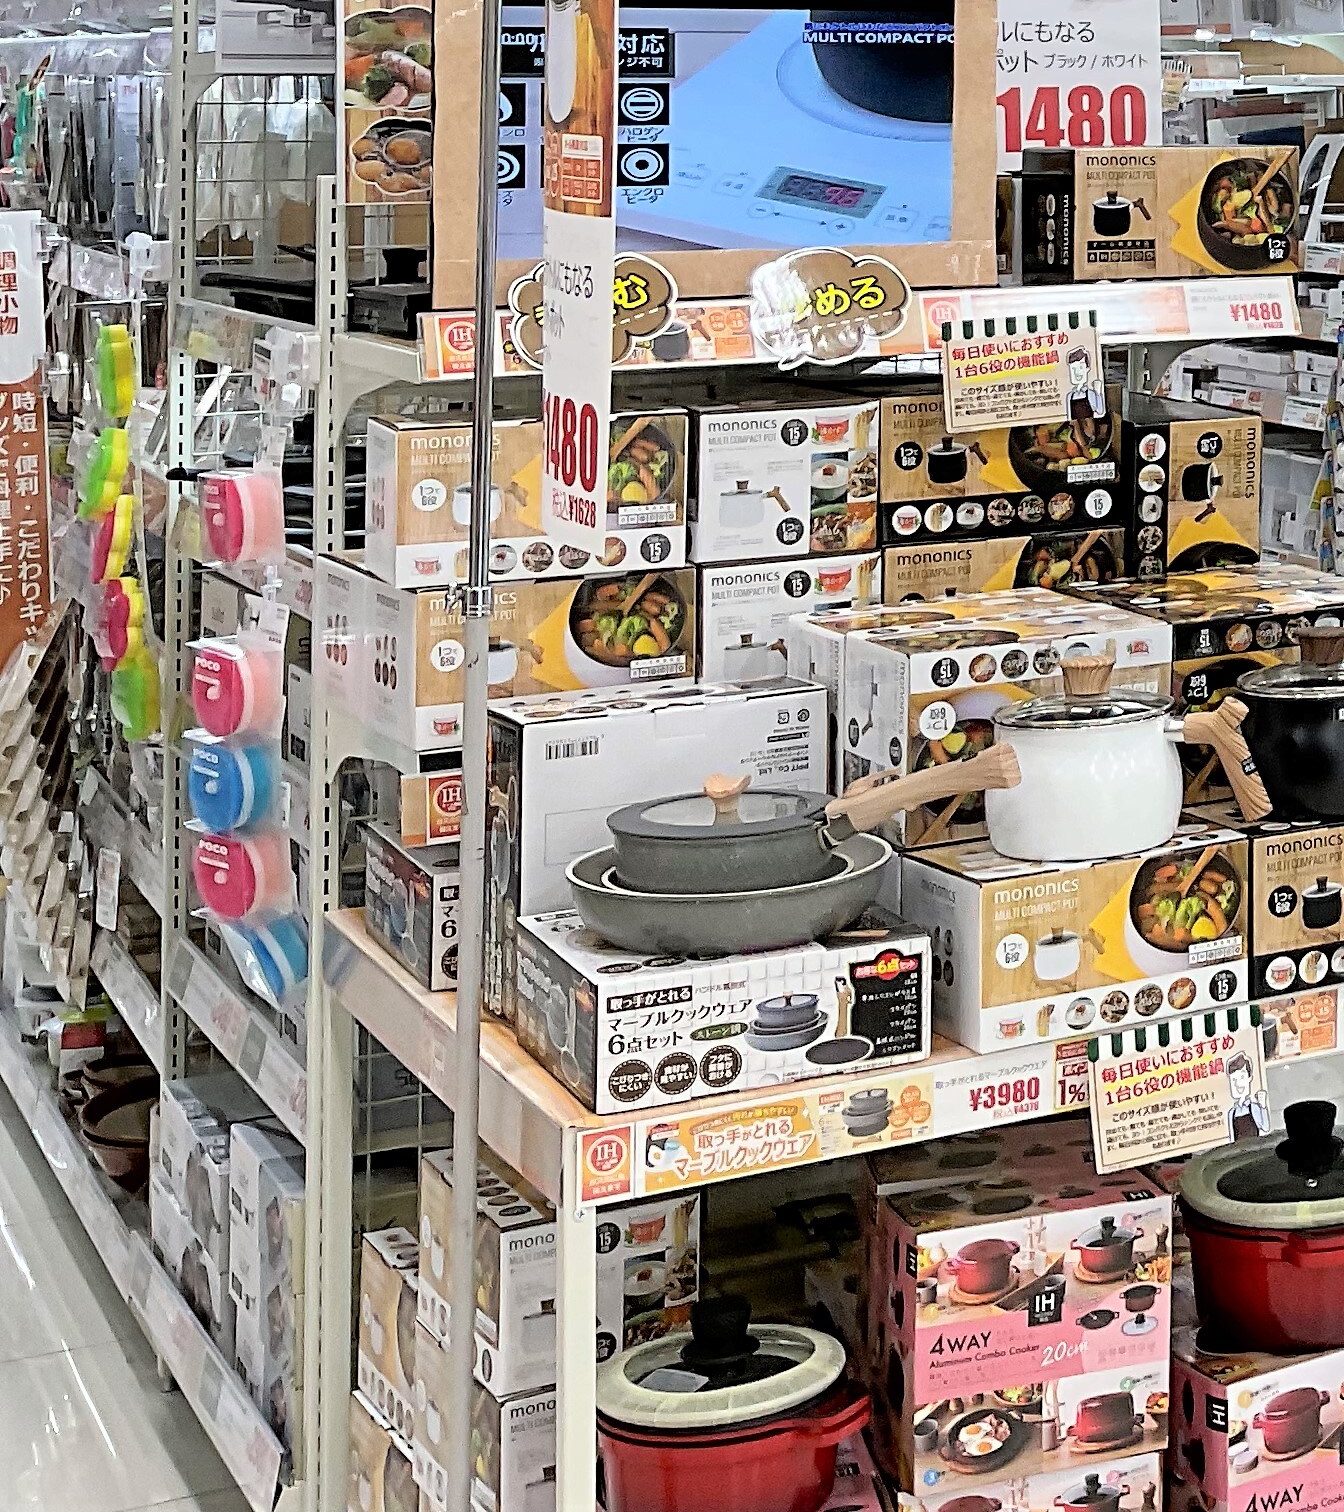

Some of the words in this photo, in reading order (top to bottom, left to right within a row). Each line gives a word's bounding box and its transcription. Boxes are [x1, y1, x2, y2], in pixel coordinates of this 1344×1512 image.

[803, 31, 852, 45] MULTI
[855, 31, 932, 45] COMPACT
[1086, 153, 1157, 167] mononics
[1229, 302, 1283, 323] ¥1480
[952, 332, 1070, 362] 毎日使いにおすすめ
[954, 351, 1060, 379] 1台6役の機能鍋
[708, 417, 778, 433] mononics
[1245, 426, 1256, 499] mononics
[896, 548, 974, 565] mononics
[711, 571, 781, 587] mononics
[1266, 833, 1344, 856] mononics
[993, 878, 1080, 905] mononics
[609, 988, 691, 1011] 取っ手がとれる
[608, 999, 753, 1031] マーブルクックウェア
[608, 1031, 683, 1054] 6点セット
[1101, 1035, 1235, 1084] 毎日使いにおすすめ
[1105, 1057, 1225, 1105] 1台6役の機能鍋
[969, 1076, 1040, 1112] ¥3980
[698, 1120, 792, 1149] 取っ手がとれる
[591, 1142, 621, 1163] IH
[1035, 1293, 1055, 1312] IH
[929, 1331, 991, 1356] 4WAY
[1040, 1340, 1088, 1367] 20cm
